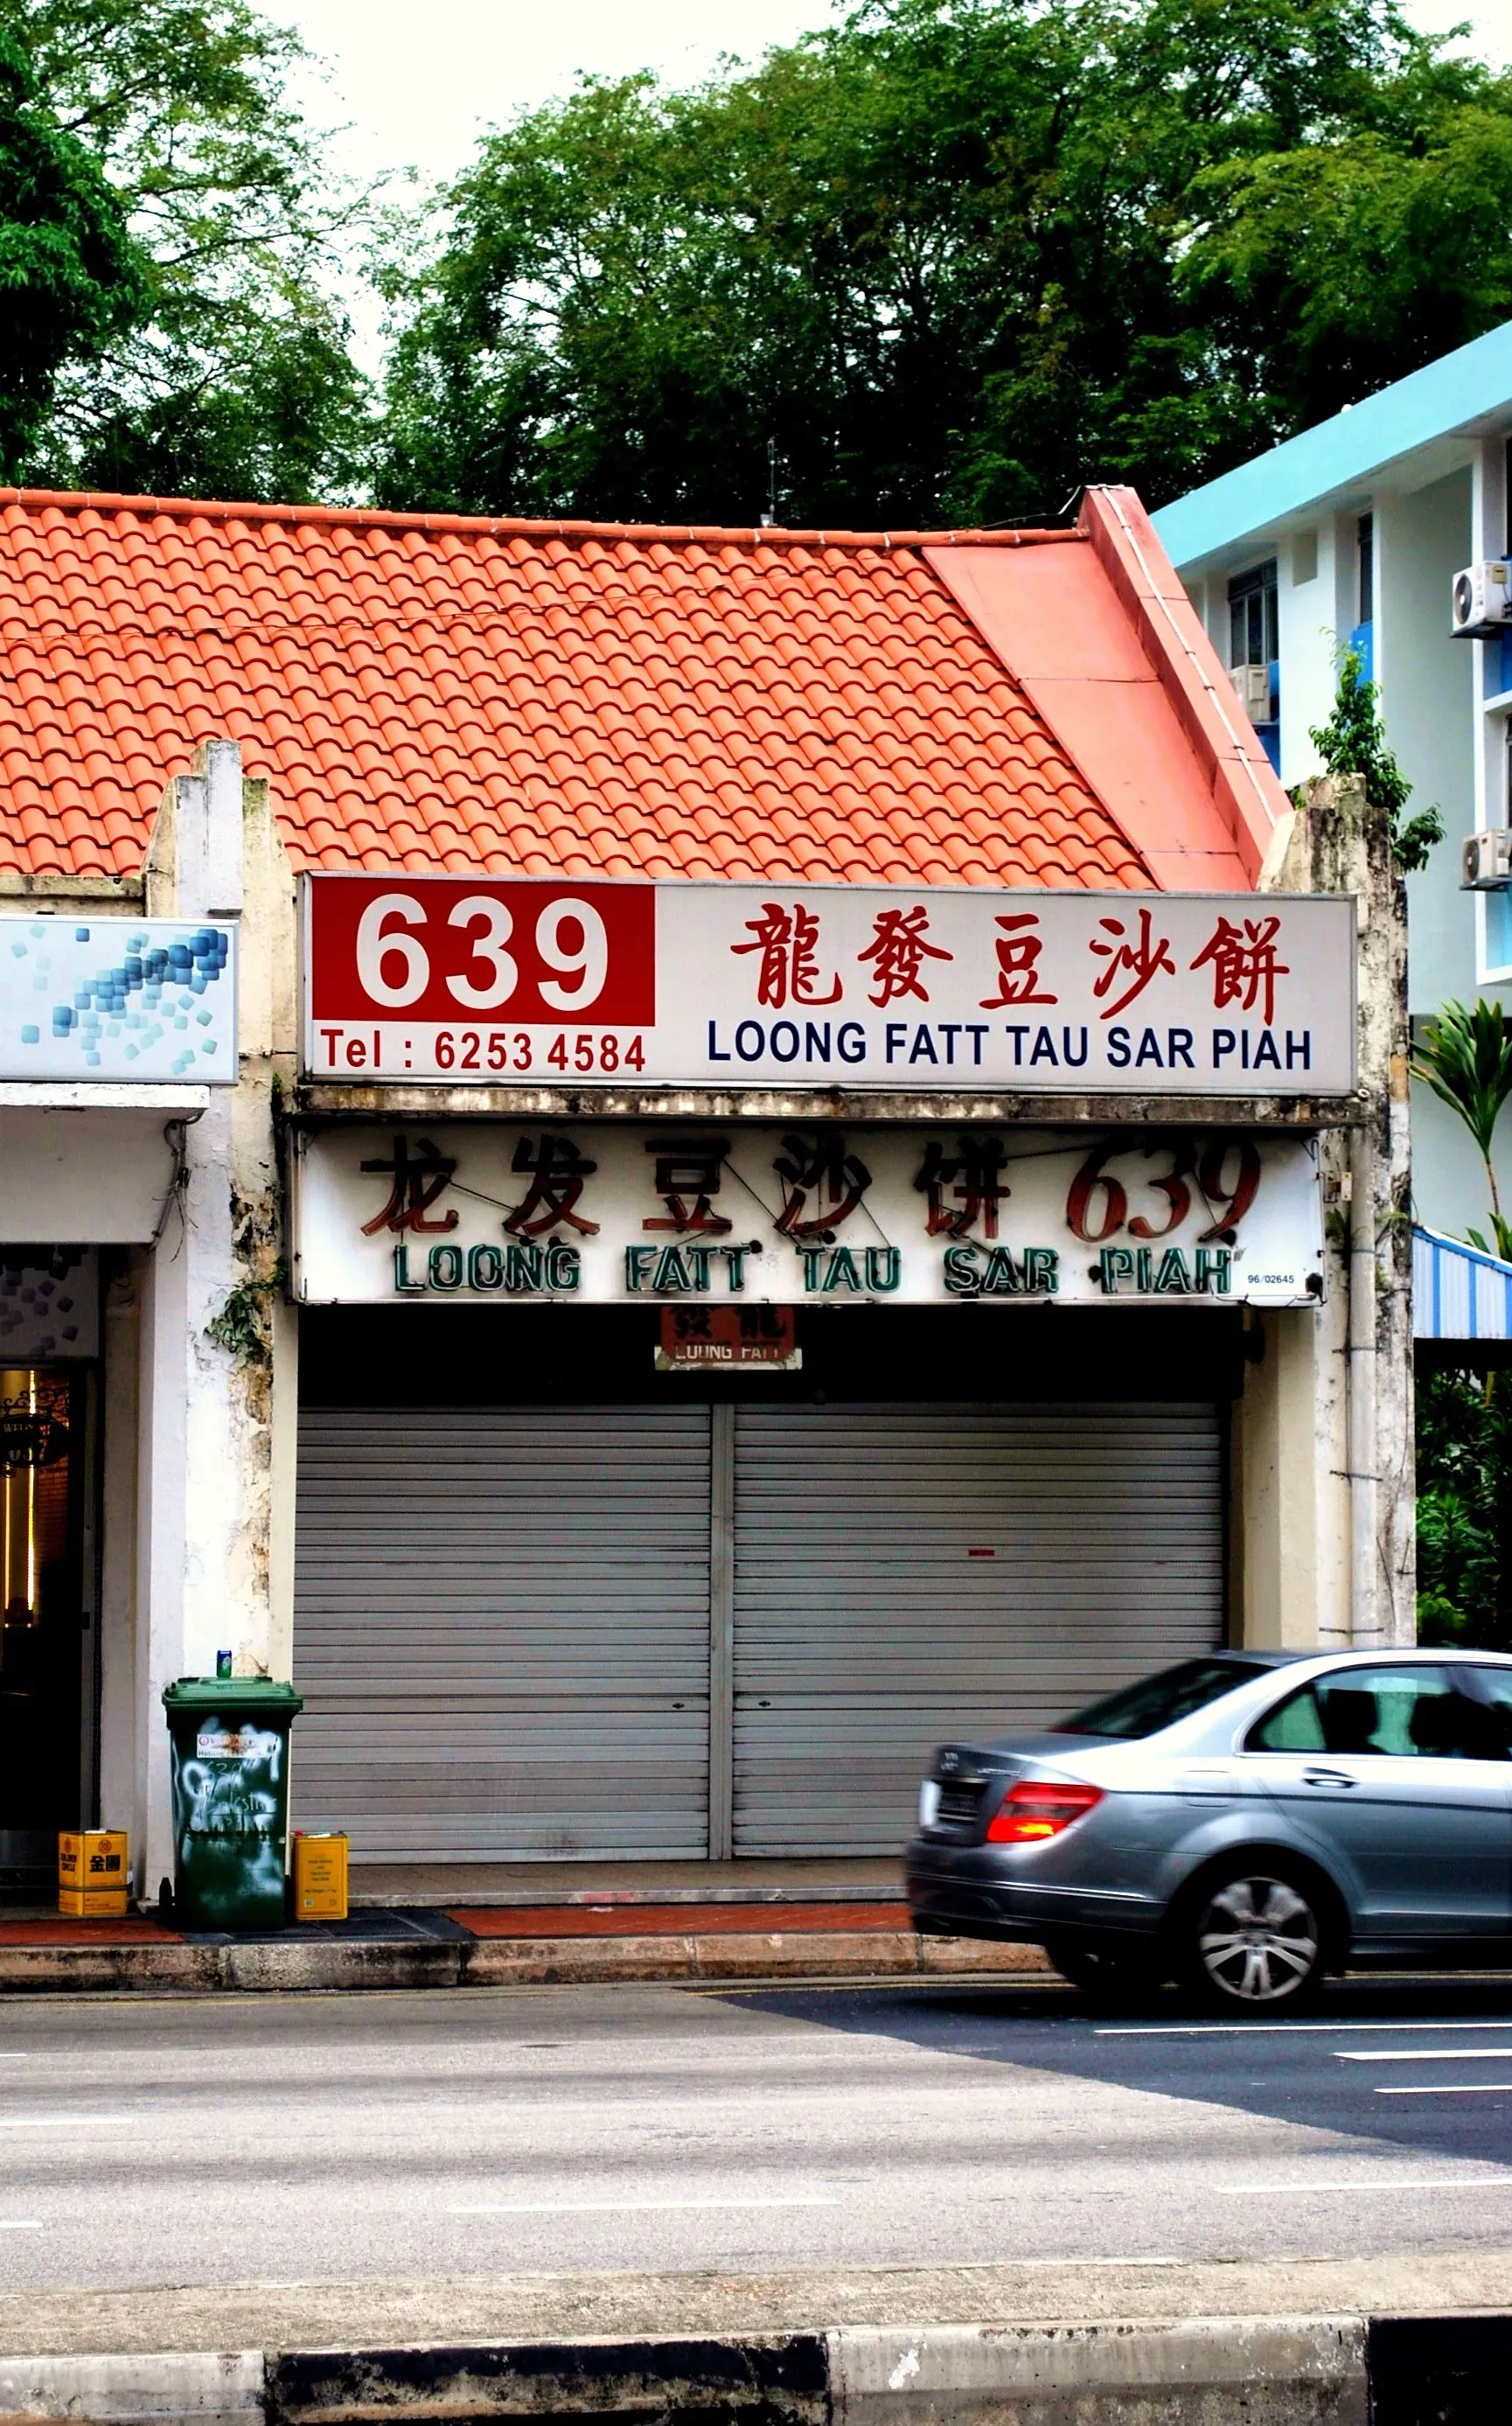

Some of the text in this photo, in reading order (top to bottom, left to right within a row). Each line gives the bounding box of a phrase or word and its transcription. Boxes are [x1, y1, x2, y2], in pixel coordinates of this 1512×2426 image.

[357, 893, 609, 1012] 639
[730, 903, 1290, 1027] 龍發豆沙餅
[320, 1028, 381, 1068] Tel
[435, 1031, 533, 1070] 6253
[547, 1035, 645, 1072] 4584
[708, 1020, 1311, 1070] LOONG FATT TAU SAR PIAH
[359, 1134, 1261, 1243] 龙发豆沙饼 639
[394, 1244, 1232, 1294] LOONG FATT TAU SAR PIAH
